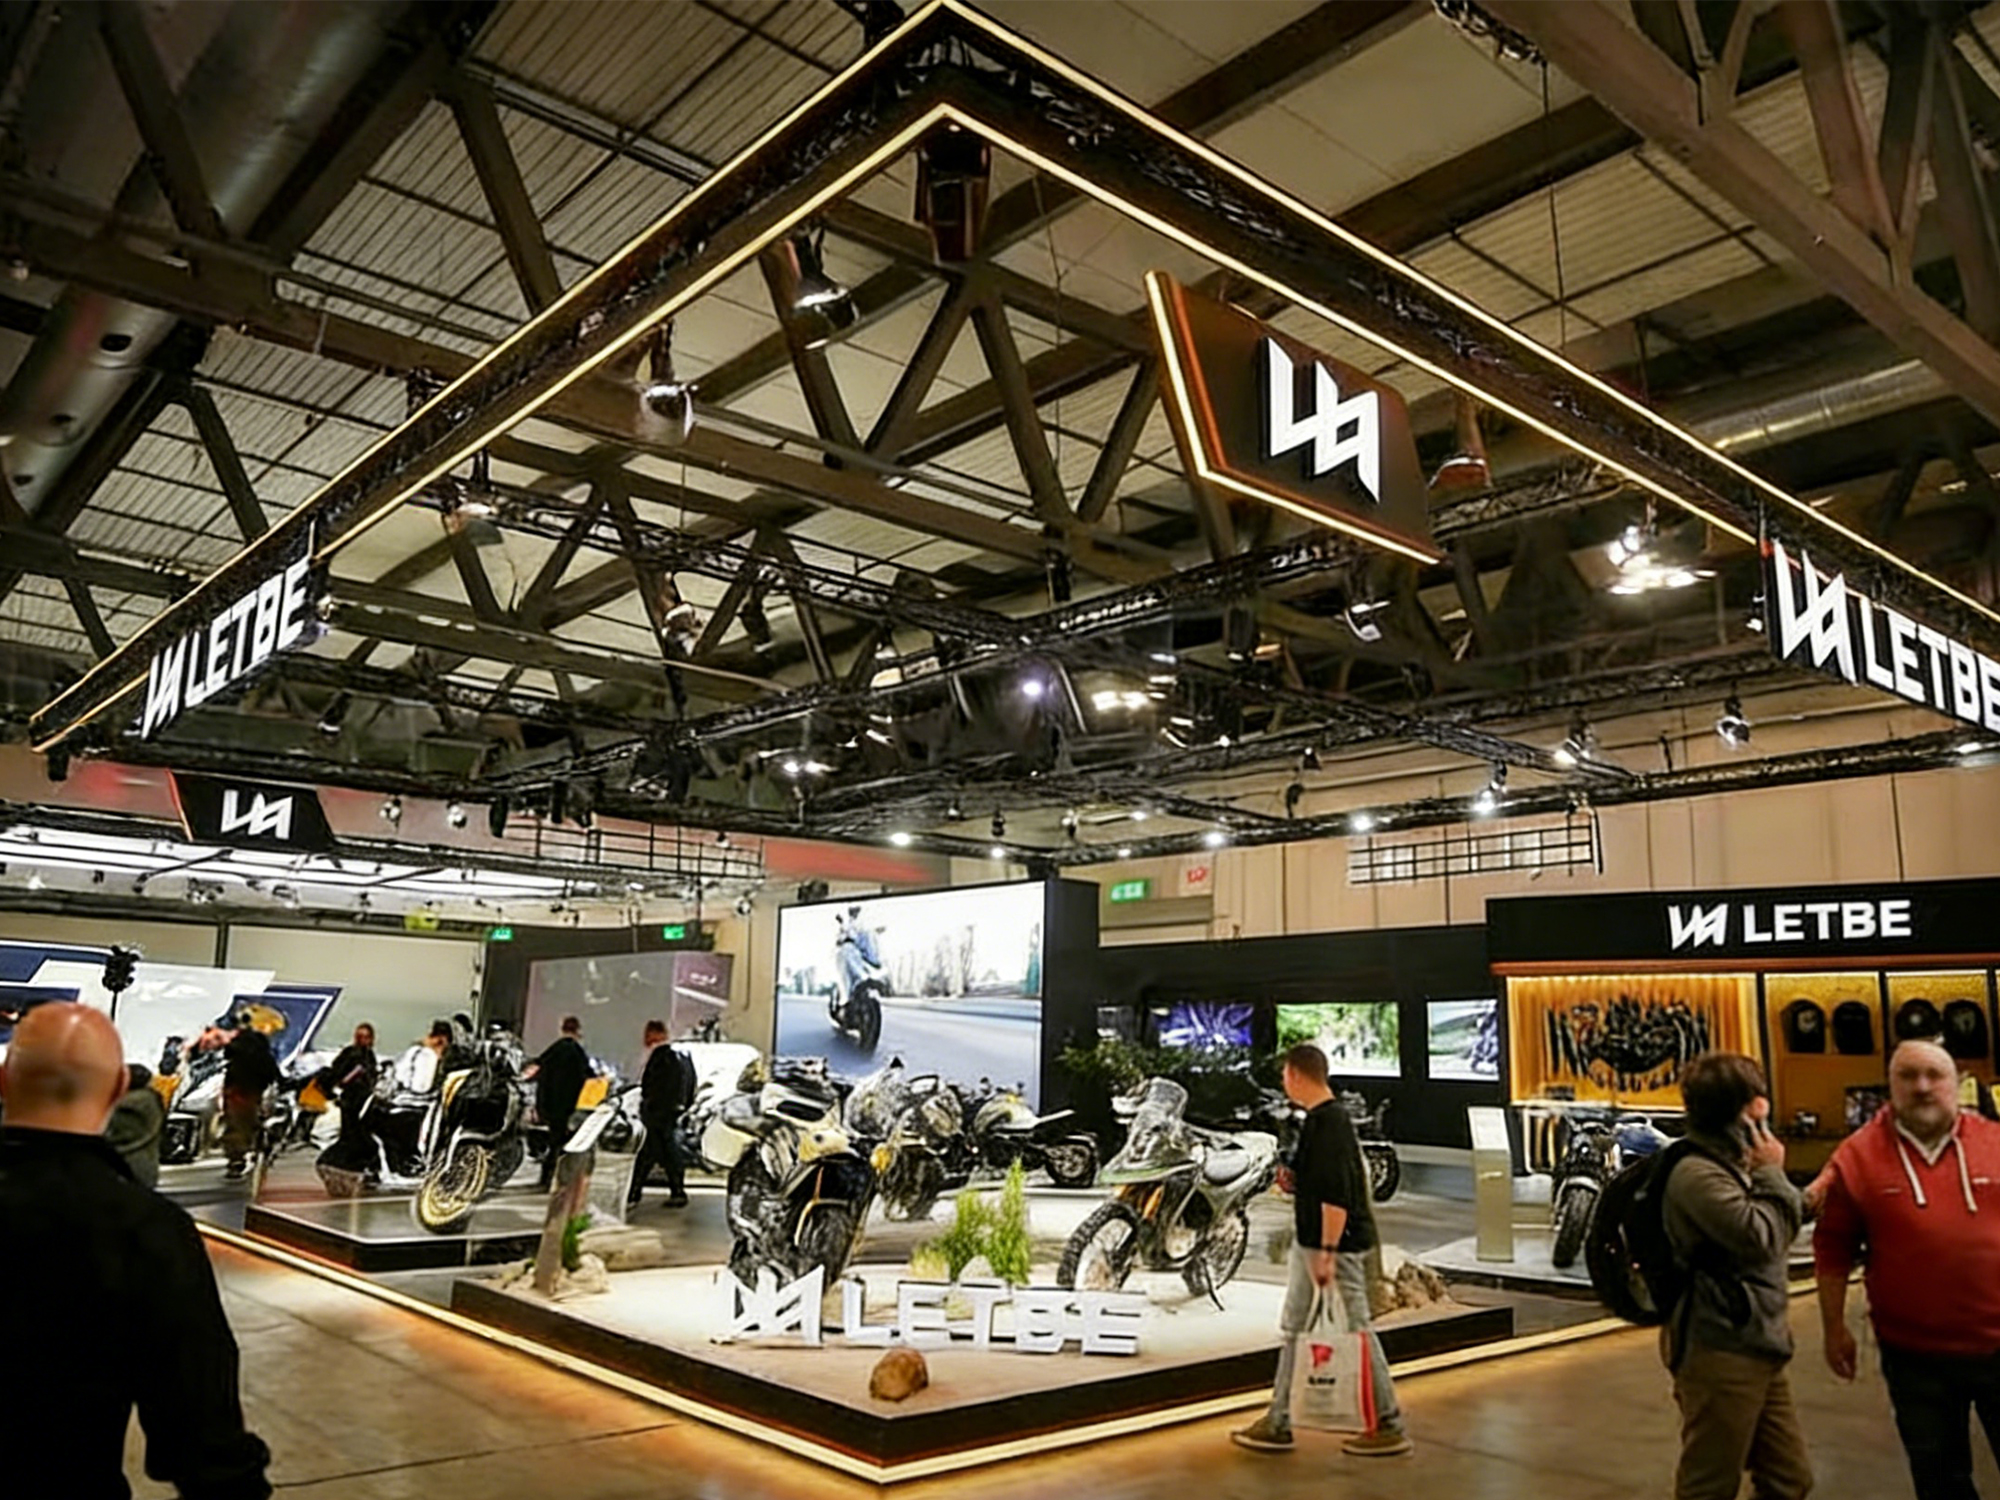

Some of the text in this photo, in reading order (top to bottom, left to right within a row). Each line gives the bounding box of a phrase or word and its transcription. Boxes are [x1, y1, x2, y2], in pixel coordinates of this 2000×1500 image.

[185, 554, 310, 708] LETBE
[1860, 596, 2000, 734] LETBE
[1743, 899, 1912, 943] LETBE
[842, 1276, 1147, 1355] LETBE
